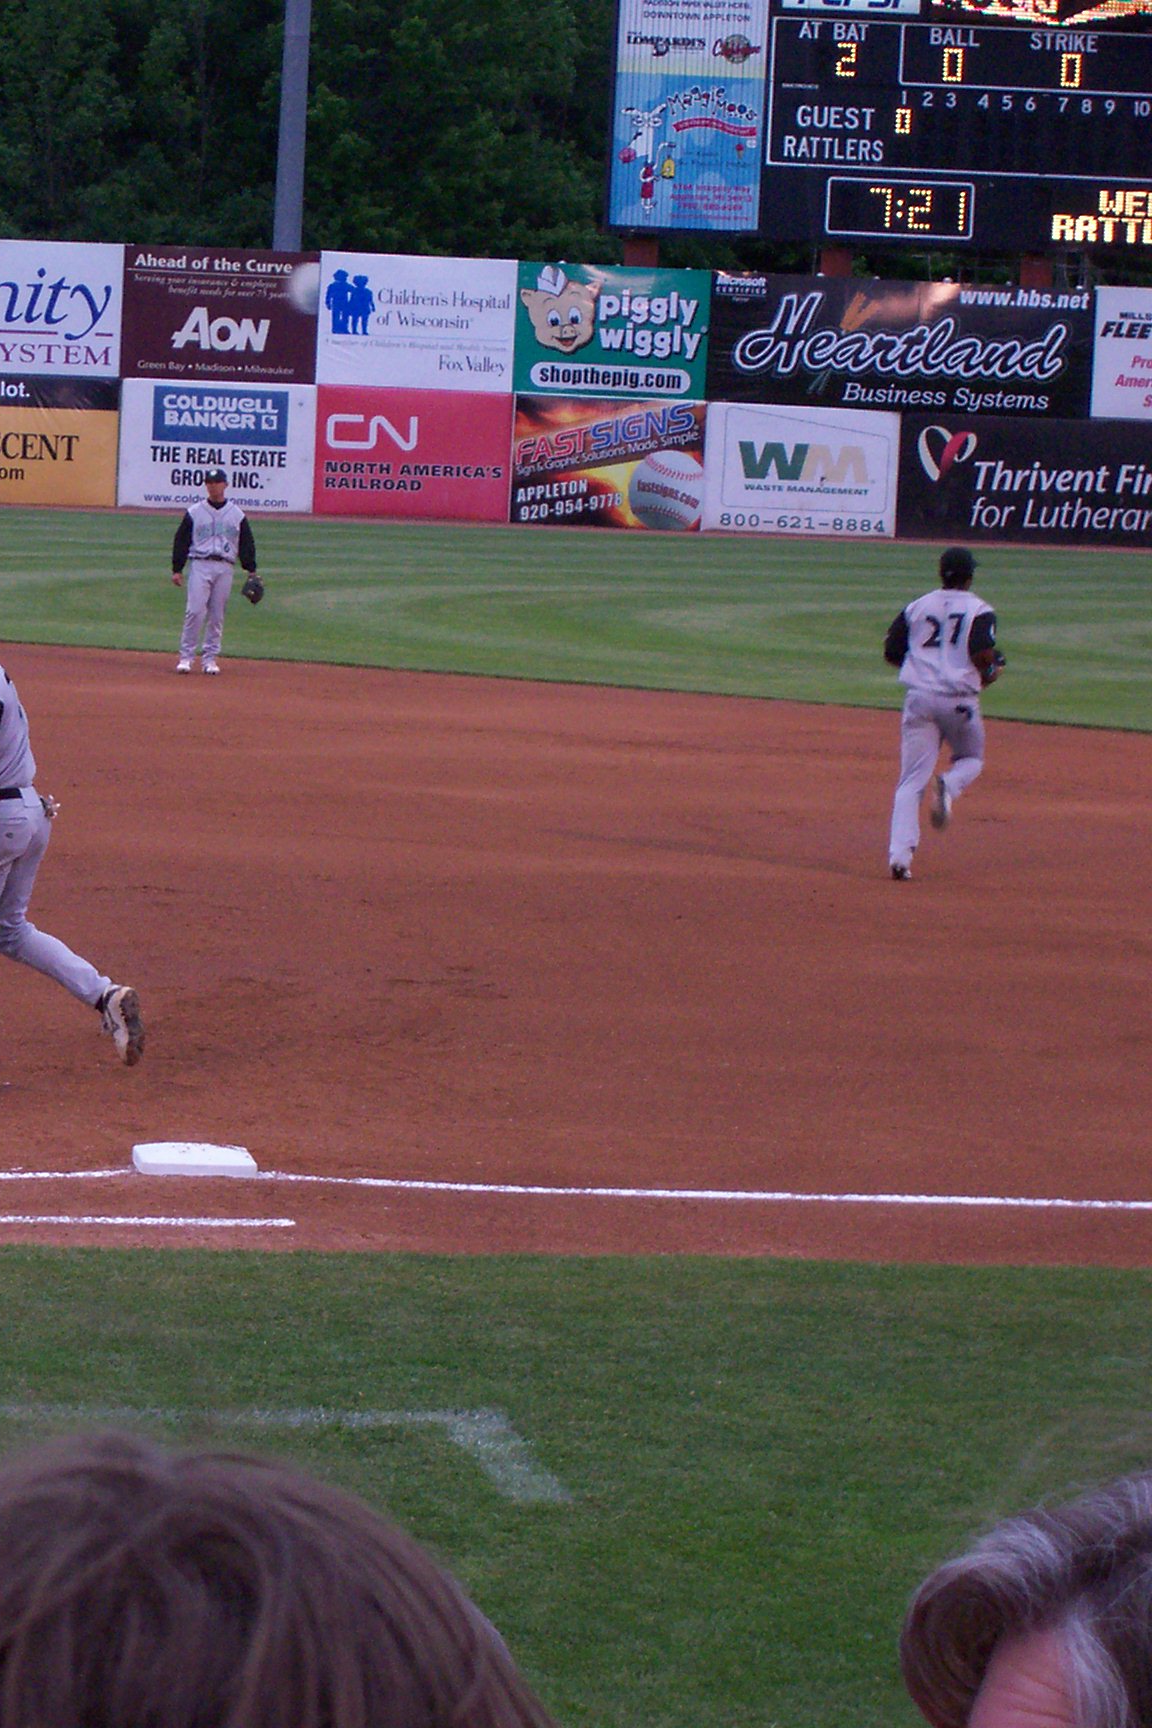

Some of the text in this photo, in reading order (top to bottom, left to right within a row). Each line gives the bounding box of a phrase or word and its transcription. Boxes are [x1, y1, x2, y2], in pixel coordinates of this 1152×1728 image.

[798, 21, 869, 41] AT BAT
[929, 28, 980, 47] BALL
[1030, 33, 1098, 52] STRIKE
[835, 42, 857, 77] 2
[941, 47, 963, 82] 0
[1060, 52, 1082, 88] 0
[922, 92, 934, 107] 2
[945, 92, 957, 108] 3
[977, 94, 990, 109] 4
[1001, 95, 1013, 110] 5
[1025, 96, 1037, 111] 6
[1058, 97, 1070, 112] 7
[1081, 98, 1093, 113] 8
[1104, 99, 1116, 115] 9
[1135, 101, 1151, 116] 10
[796, 105, 876, 130] GUEST
[895, 108, 911, 134] 0
[783, 135, 884, 162] RATTLERS
[869, 187, 967, 231] 7:21
[134, 253, 294, 274] Ahead of the Curve
[377, 287, 511, 314] Children's Hospital
[599, 288, 699, 327] piggly
[960, 287, 1090, 310] www.hbs.net
[376, 310, 470, 330] of Wisconsin
[599, 321, 701, 361] wiggly
[734, 291, 1069, 379] Heartland
[438, 353, 507, 377] Fox Valley
[539, 364, 682, 389] shopthepig.com
[0, 381, 31, 398] lot.
[842, 381, 1050, 413] Business Systems
[163, 393, 279, 414] COLDWELL
[163, 411, 256, 431] BANKER
[325, 413, 419, 451] CN
[514, 402, 696, 466] FASTSIGNS
[150, 445, 287, 468] THE REAL ESTATE
[738, 440, 871, 485] WM
[231, 471, 265, 490] INC.
[325, 461, 503, 479] NORTH AMERICA'S
[973, 460, 1111, 493] Thrivent
[325, 476, 423, 492] RAILROAD
[516, 478, 589, 503] APPLETON
[744, 483, 870, 496] WASTE MANAGEMENT
[719, 512, 886, 533] 800-621-8884
[969, 496, 1016, 528] for
[922, 612, 968, 648] 27
